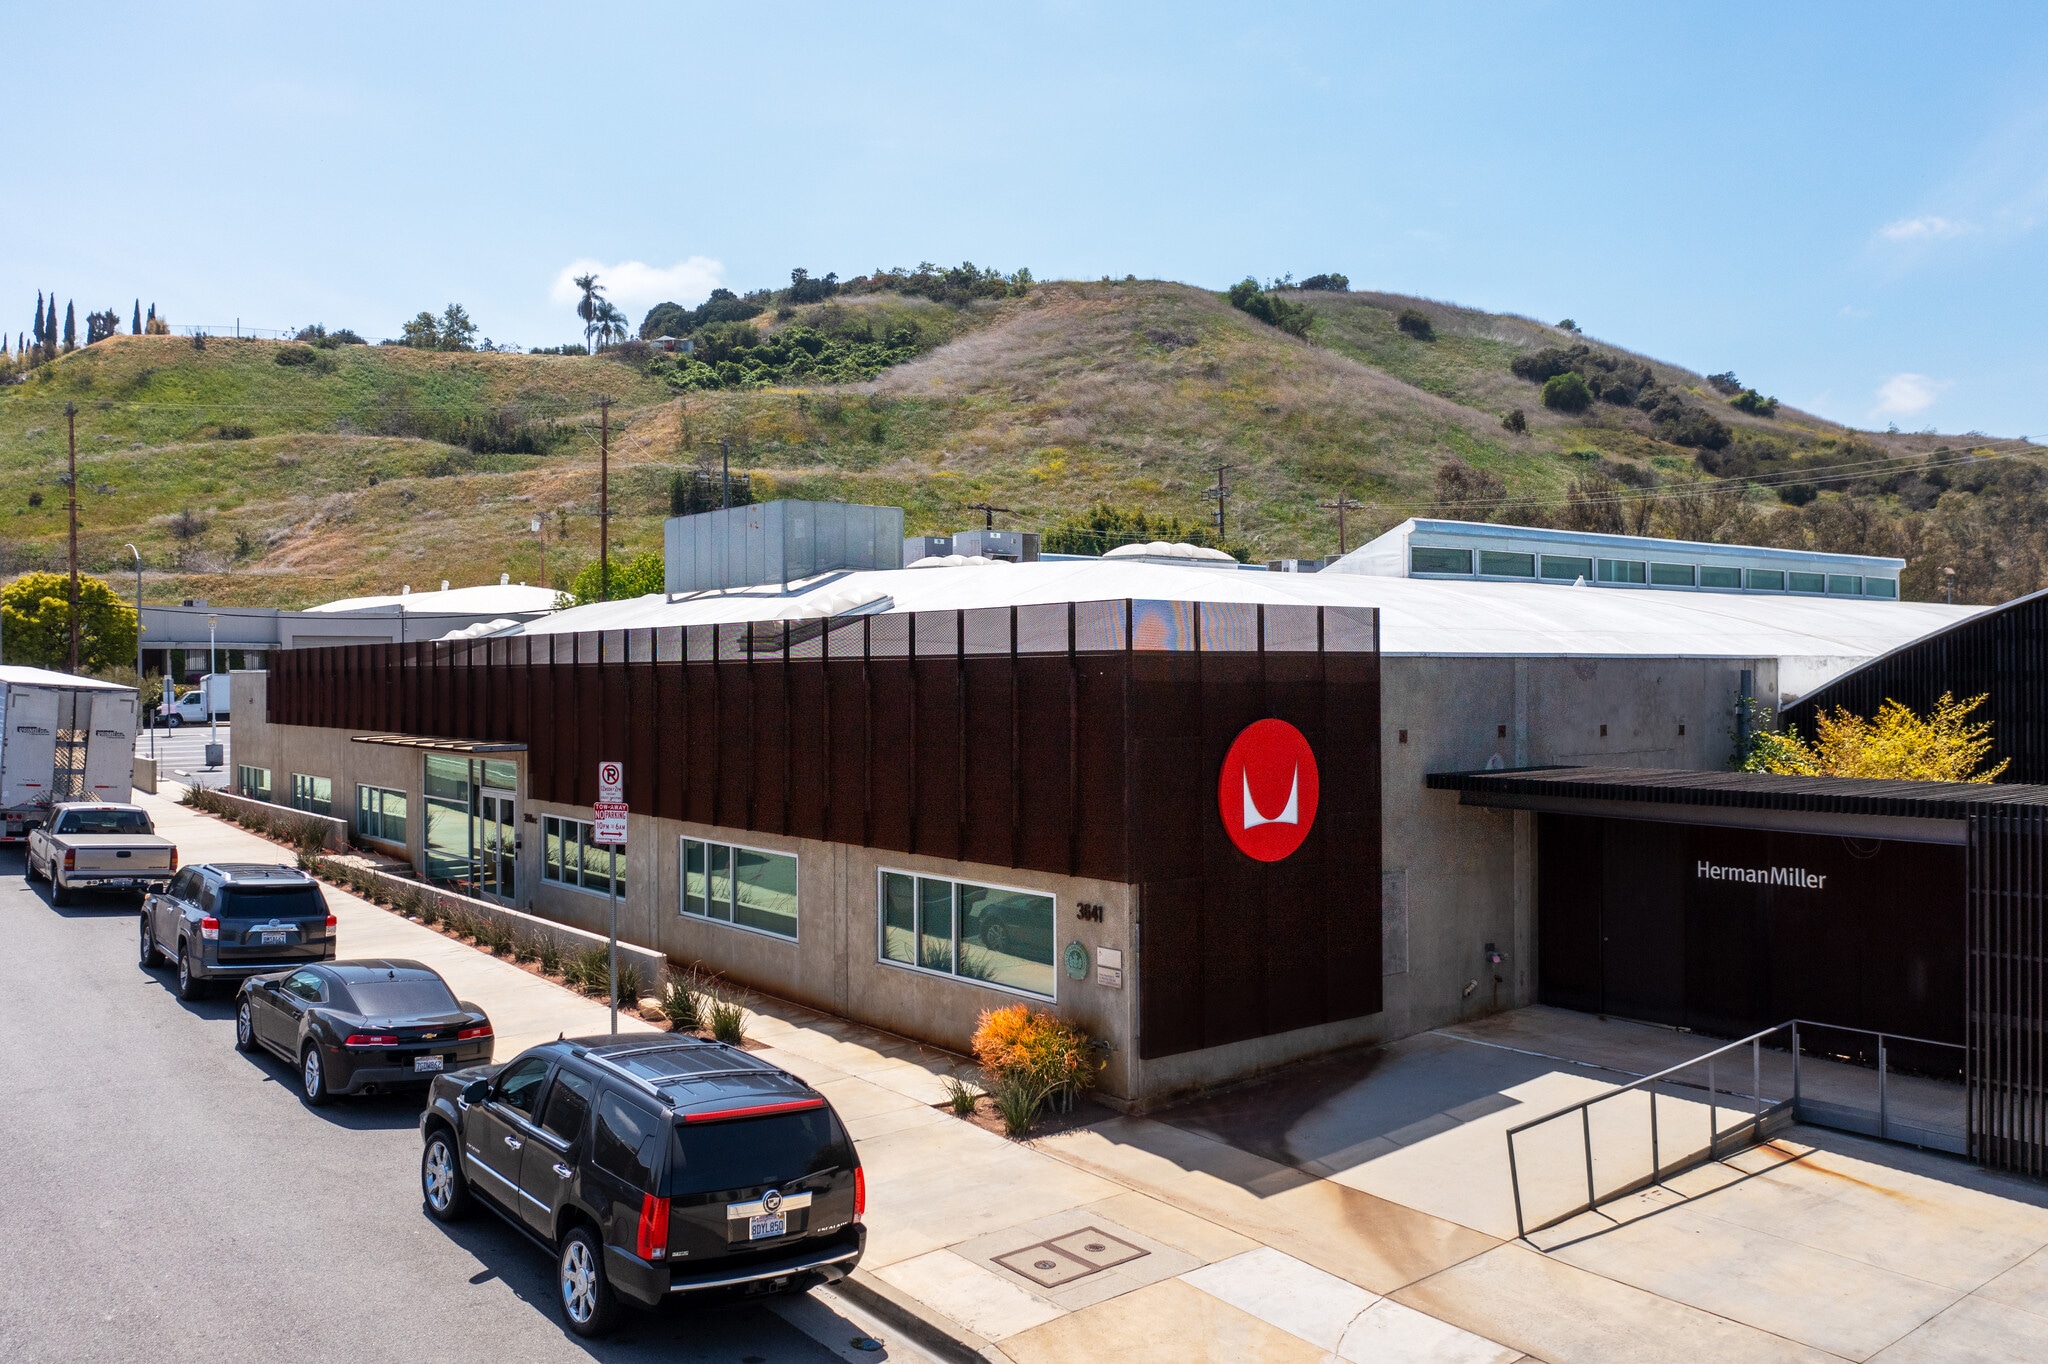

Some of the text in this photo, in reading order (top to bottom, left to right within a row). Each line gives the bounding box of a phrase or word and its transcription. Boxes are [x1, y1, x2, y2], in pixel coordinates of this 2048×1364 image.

[595, 810, 626, 820] NO PARKING
[597, 822, 609, 830] 10PM
[1697, 860, 1827, 889] HermanMiller
[751, 1219, 784, 1236] 8DYL850
